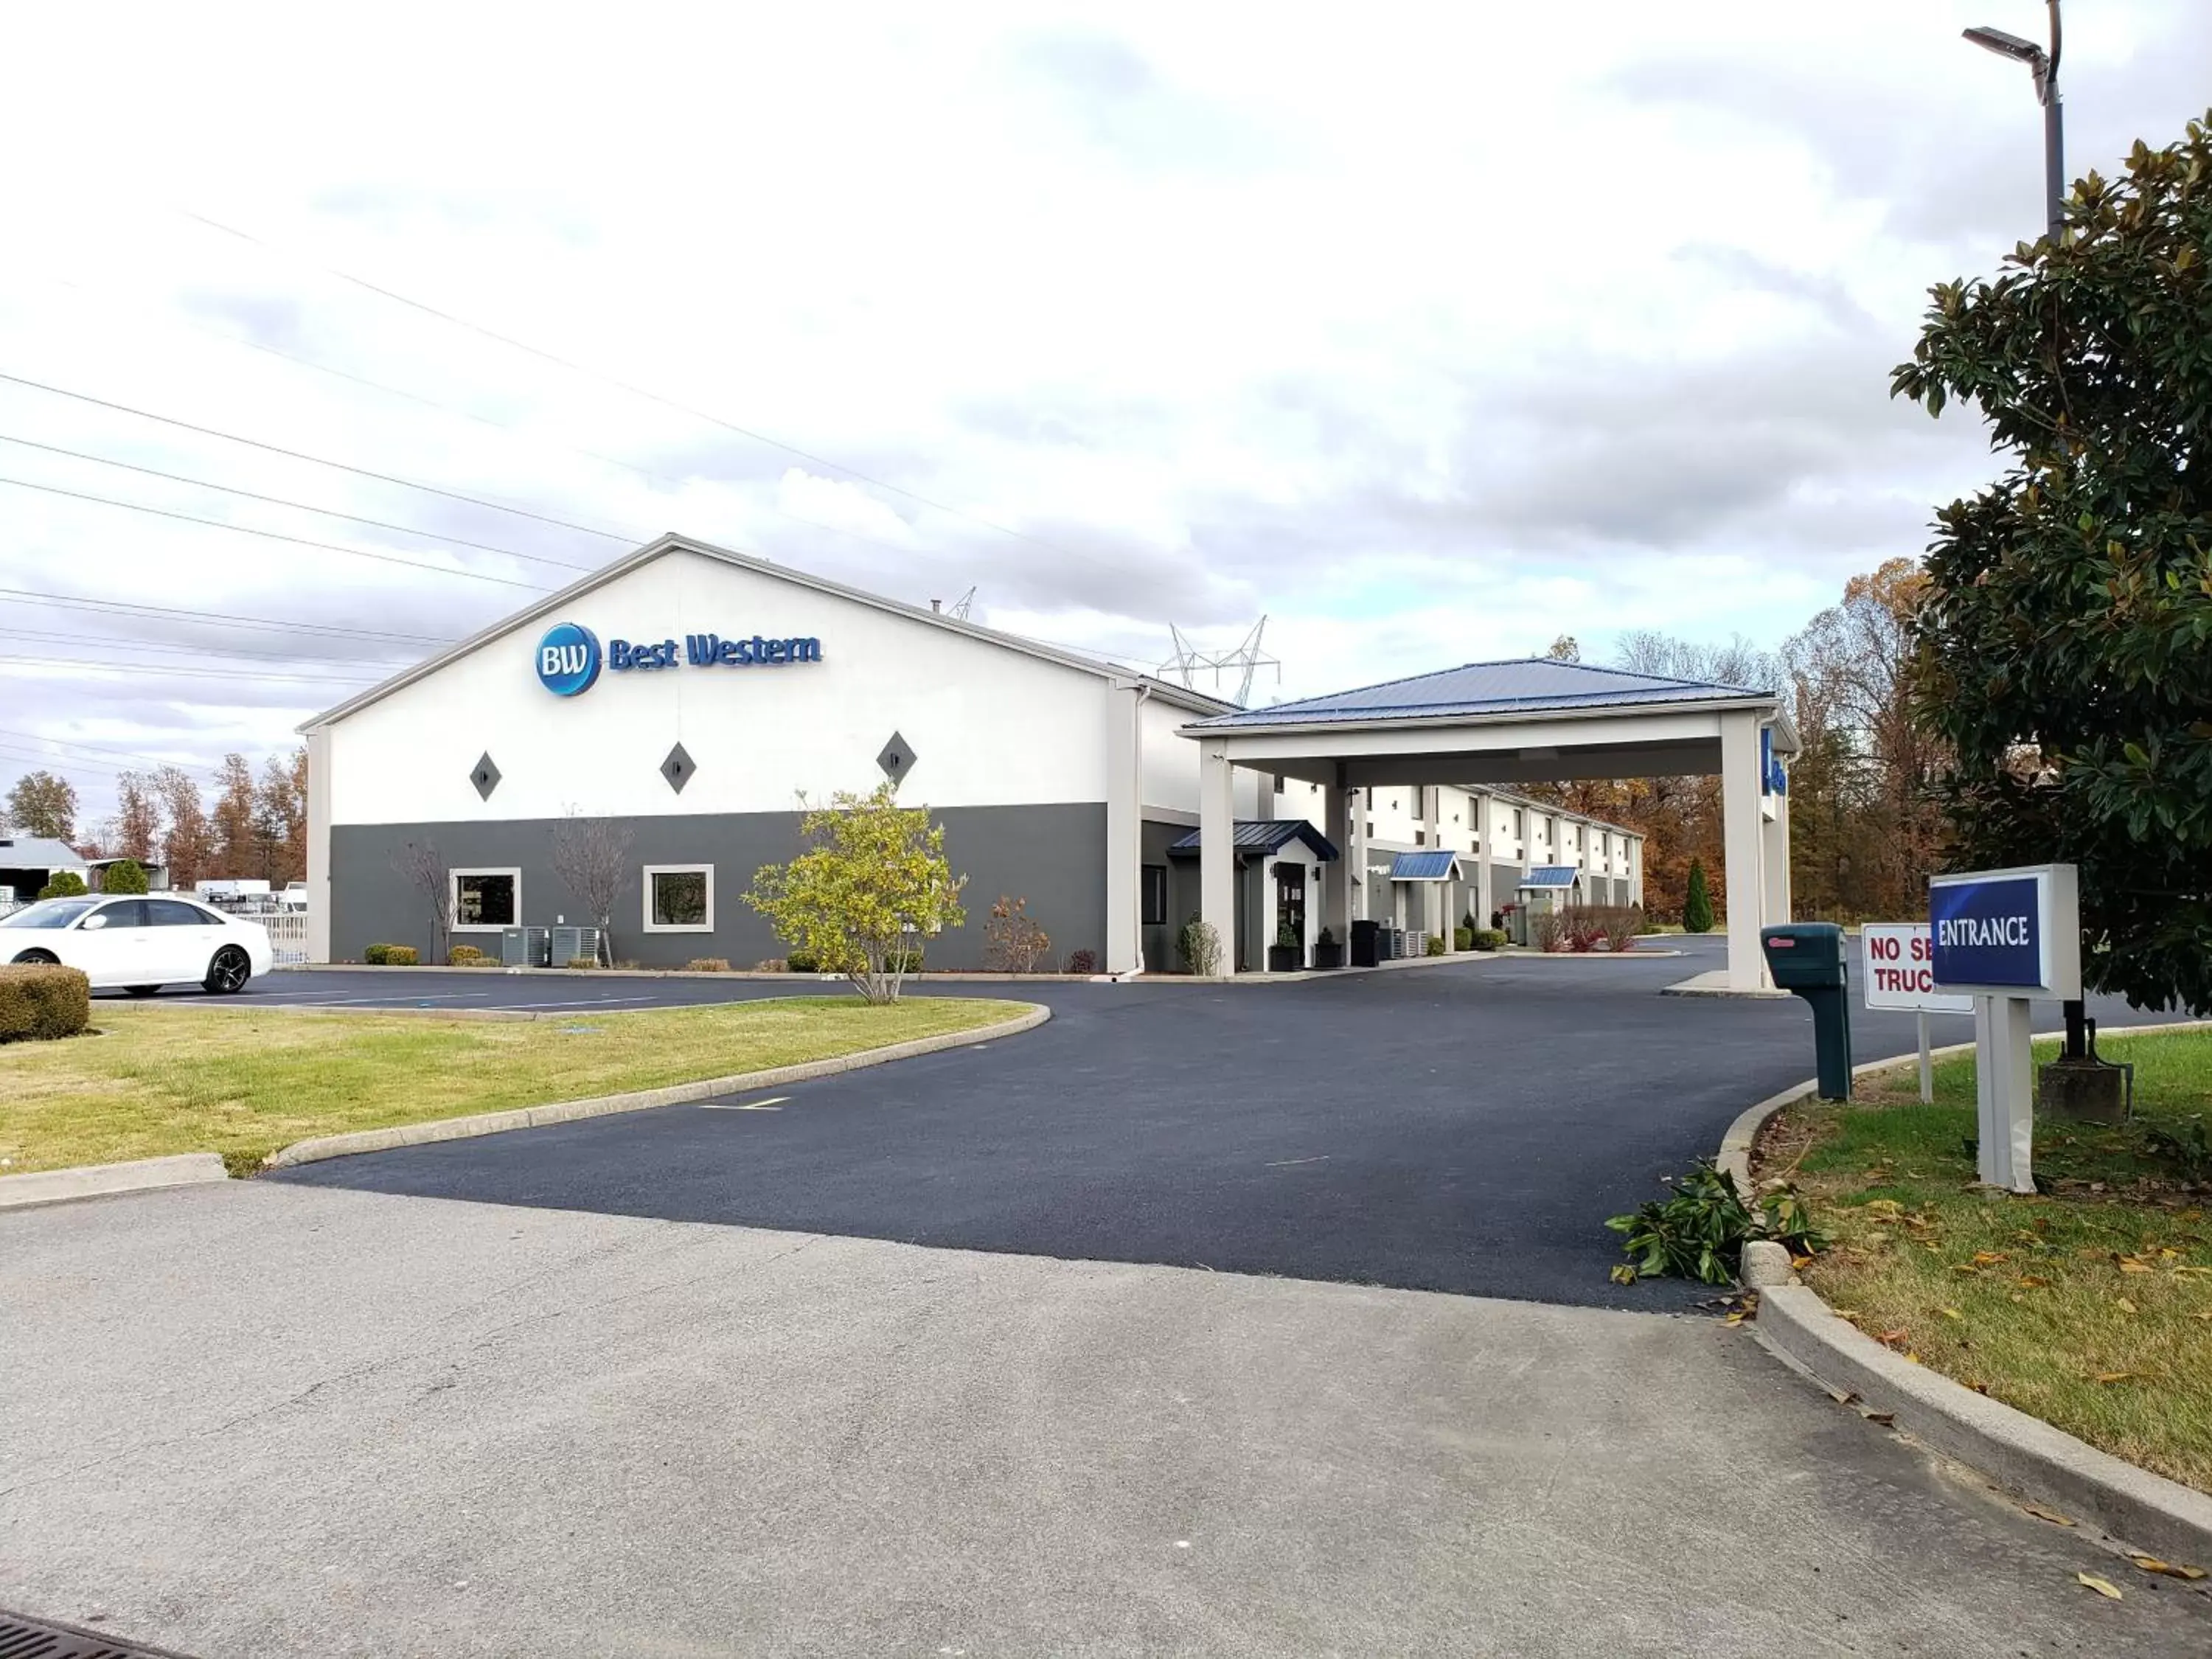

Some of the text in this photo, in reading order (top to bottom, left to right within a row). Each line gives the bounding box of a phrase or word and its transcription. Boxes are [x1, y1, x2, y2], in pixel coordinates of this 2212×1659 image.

[542, 646, 587, 676] BW
[610, 634, 821, 669] Best Western
[1938, 917, 2028, 946] ENTRANCE
[1871, 938, 1932, 961] NO SE
[1875, 969, 1932, 992] TRUC
